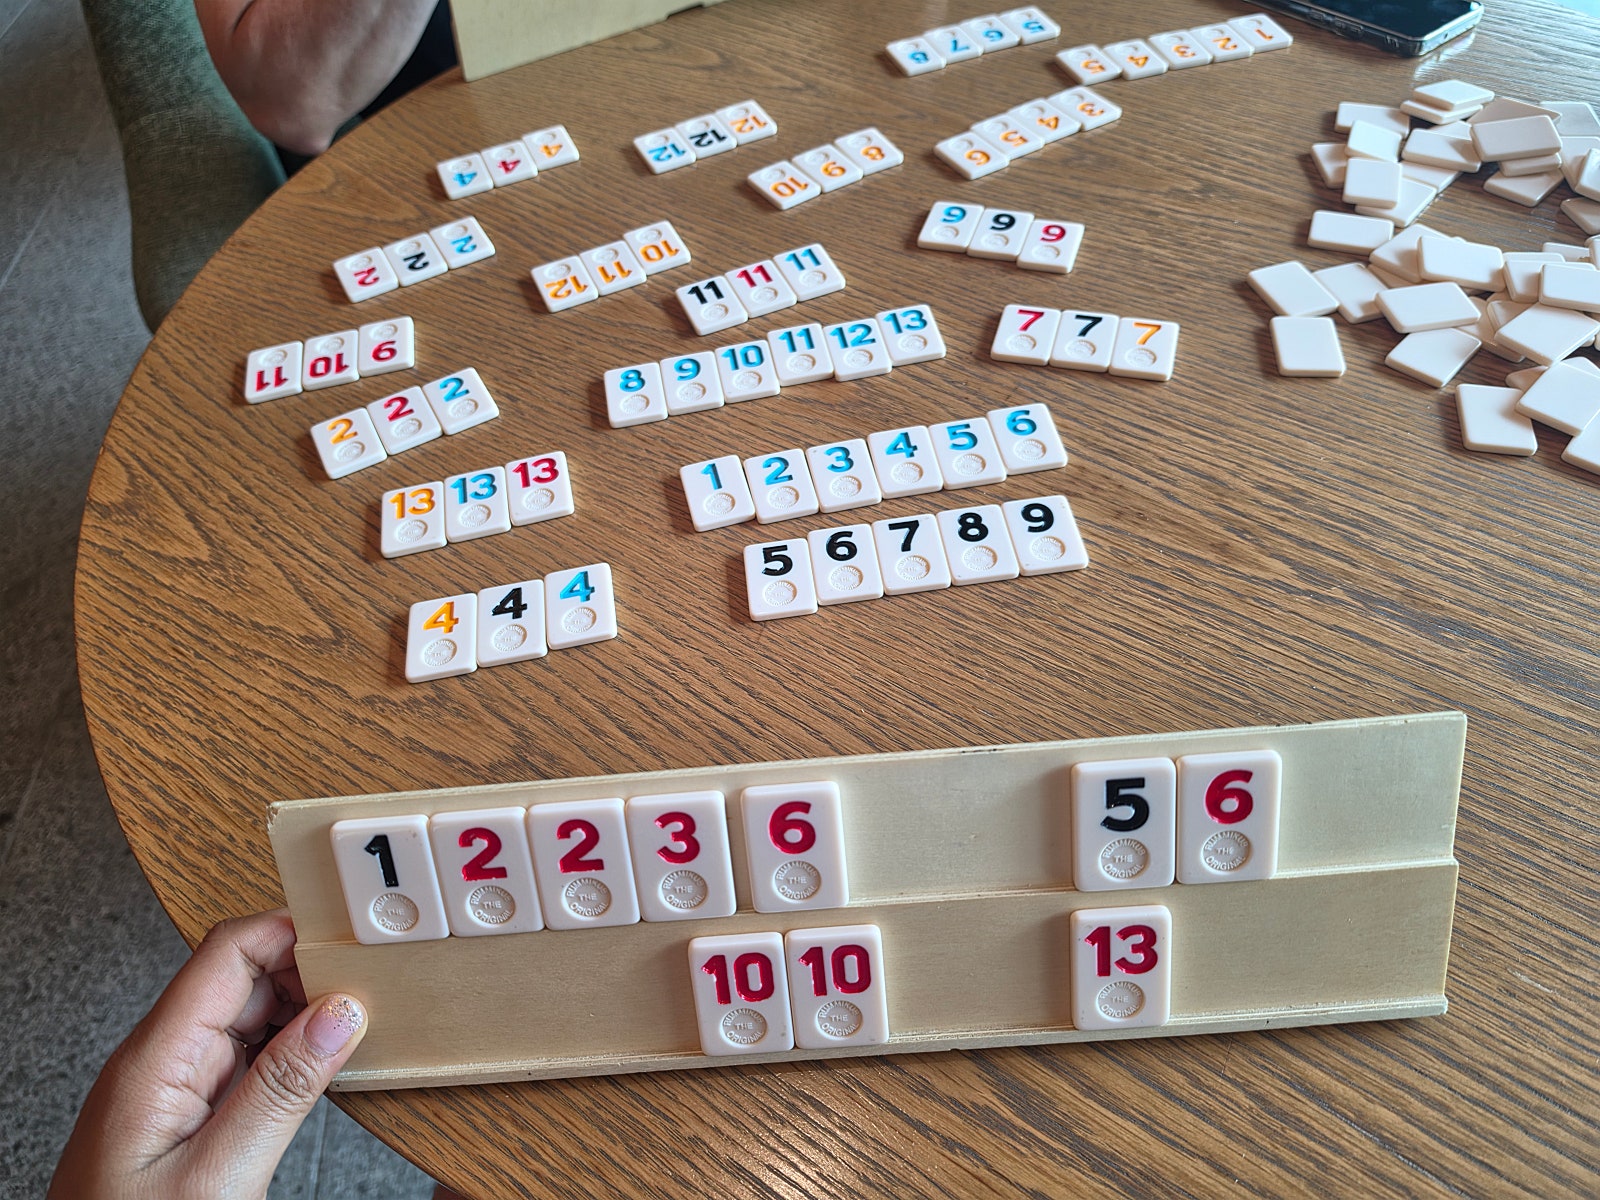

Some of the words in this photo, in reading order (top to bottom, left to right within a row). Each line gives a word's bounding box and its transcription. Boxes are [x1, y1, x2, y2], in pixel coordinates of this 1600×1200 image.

[1256, 29, 1274, 41] 1
[1174, 45, 1197, 58] 3
[1212, 37, 1238, 50] 2
[1082, 60, 1106, 73] 5
[1127, 55, 1149, 67] 4
[1080, 104, 1103, 115] 3
[732, 116, 765, 132] 12
[1038, 117, 1058, 129] 4
[690, 130, 726, 146] 12
[1002, 132, 1026, 146] 5
[542, 145, 561, 157] 4
[648, 143, 685, 162] 12
[862, 147, 884, 160] 8
[966, 150, 990, 165] 6
[499, 161, 519, 173] 4
[822, 162, 845, 176] 9
[453, 172, 477, 187] 4
[771, 178, 807, 197] 10
[940, 206, 966, 224] 9
[990, 214, 1015, 230] 9
[1041, 225, 1065, 242] 9
[450, 235, 476, 254] 2
[640, 240, 678, 262] 10
[404, 253, 428, 270] 2
[354, 268, 378, 286] 2
[598, 262, 631, 283] 11
[686, 279, 723, 304] 11
[734, 264, 771, 287] 11
[785, 248, 821, 271] 11
[546, 276, 587, 299] 12
[1018, 310, 1044, 331] 7
[1076, 315, 1102, 336] 7
[1134, 322, 1161, 344] 7
[372, 341, 396, 362] 9
[619, 369, 645, 392] 8
[674, 358, 700, 381] 9
[721, 345, 764, 369] 10
[778, 328, 814, 353] 11
[829, 324, 875, 349] 12
[883, 310, 927, 334] 13
[309, 354, 348, 378] 10
[256, 367, 287, 391] 11
[328, 419, 357, 444] 2
[384, 397, 413, 421] 2
[439, 377, 469, 402] 2
[701, 463, 722, 490] 1
[763, 457, 793, 486] 2
[824, 446, 853, 473] 3
[885, 432, 917, 458] 4
[946, 424, 978, 451] 5
[1006, 410, 1037, 436] 6
[390, 488, 435, 519] 13
[450, 473, 496, 504] 13
[513, 458, 558, 488] 13
[762, 545, 792, 576] 5
[826, 531, 857, 561] 6
[889, 520, 919, 552] 7
[958, 513, 988, 542] 8
[1021, 503, 1054, 532] 9
[423, 602, 458, 634] 4
[492, 588, 527, 619] 4
[559, 571, 594, 603] 4
[1101, 777, 1149, 832] 5
[1205, 770, 1253, 824] 6
[364, 834, 399, 888] 1
[458, 827, 507, 881] 2
[556, 819, 604, 873] 2
[654, 812, 700, 864] 3
[769, 801, 816, 854] 6
[1104, 863, 1145, 879] ORIGINAL
[1205, 855, 1246, 871] ORIGINAL
[788, 876, 807, 884] THE
[578, 893, 598, 902] THE
[675, 885, 693, 894] THE
[778, 884, 818, 900] ORIGINAL
[483, 901, 502, 909] THE
[570, 902, 609, 917] ORIGINAL
[666, 894, 705, 909] ORIGINAL
[474, 909, 513, 924] ORIGINAL
[1085, 925, 1158, 977] 13
[701, 952, 774, 1005] 10
[798, 945, 871, 996] 10
[1112, 996, 1129, 1004] THE
[830, 1014, 849, 1022] THE
[1101, 1004, 1140, 1018] ORIGINAL
[726, 1030, 764, 1044] ORIGINAL
[821, 1023, 859, 1037] ORIGINAL
